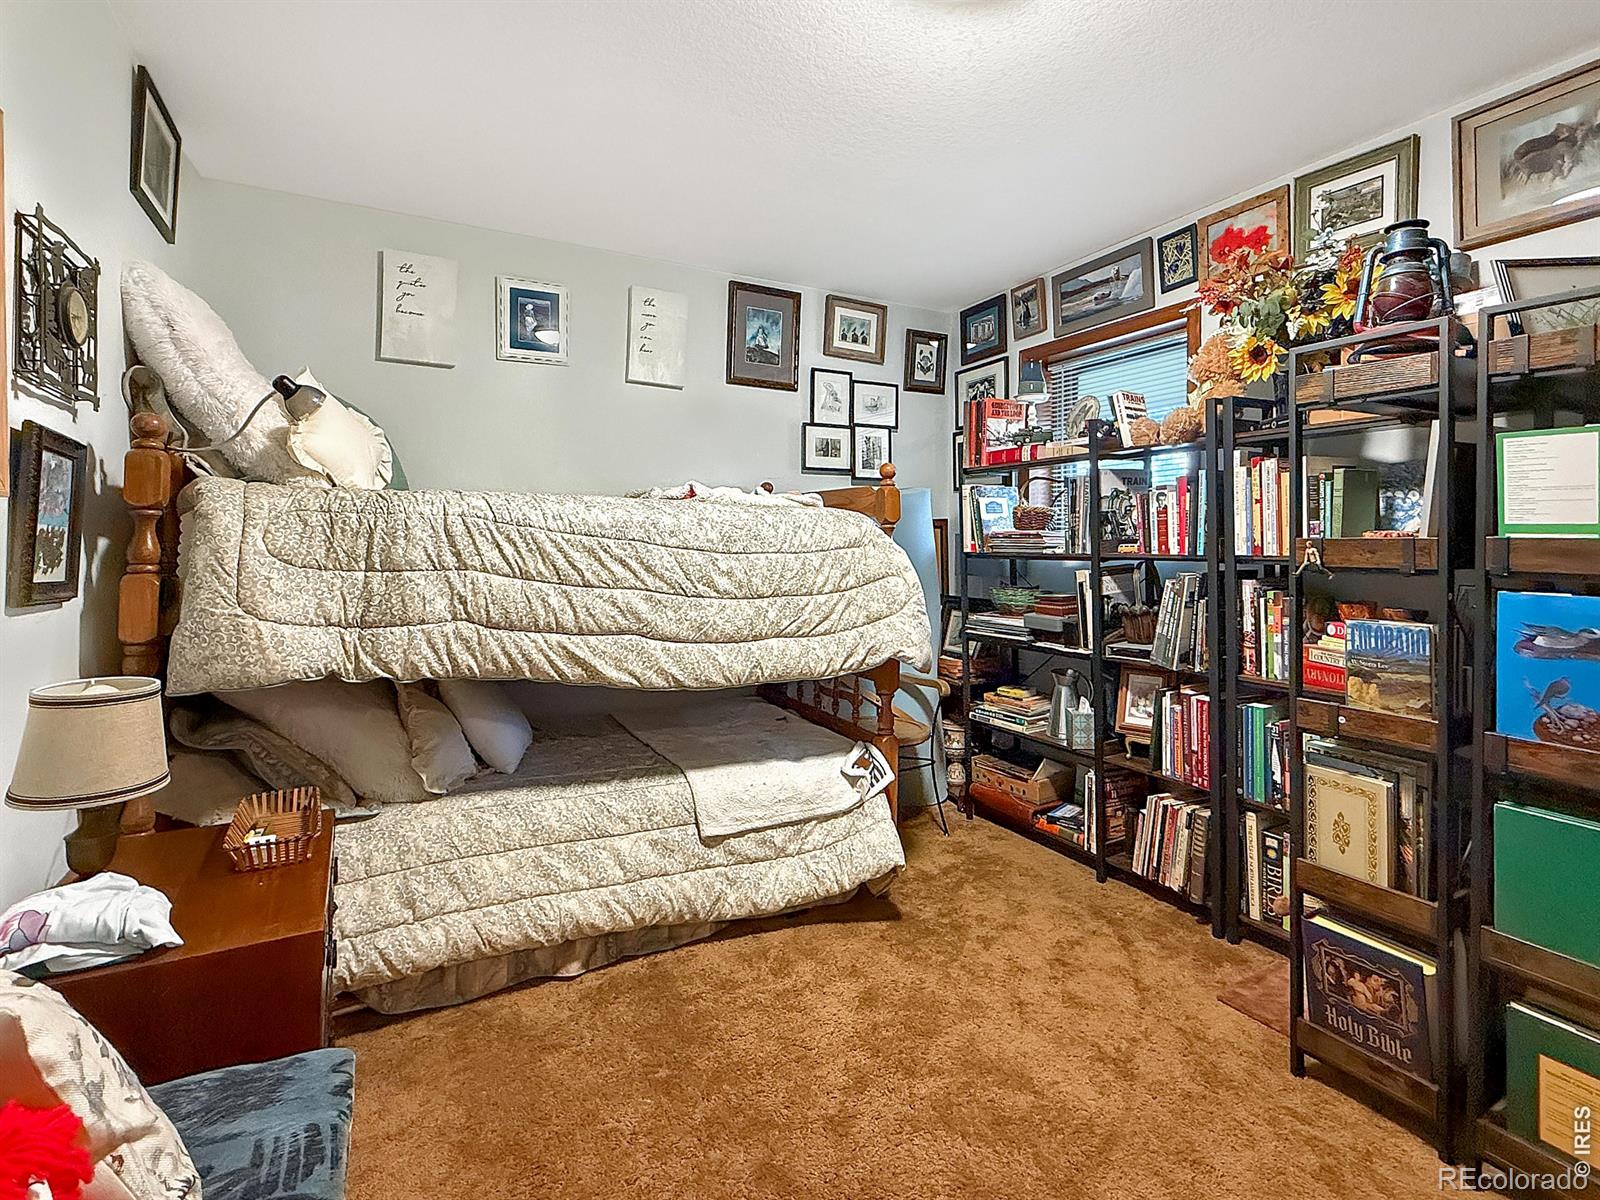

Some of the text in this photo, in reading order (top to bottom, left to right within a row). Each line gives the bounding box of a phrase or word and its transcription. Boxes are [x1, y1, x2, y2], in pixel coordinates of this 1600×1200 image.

[1121, 477, 1148, 486] TRAIN
[1313, 654, 1340, 666] COUNTRY
[1323, 1003, 1413, 1065] Holy Bible
